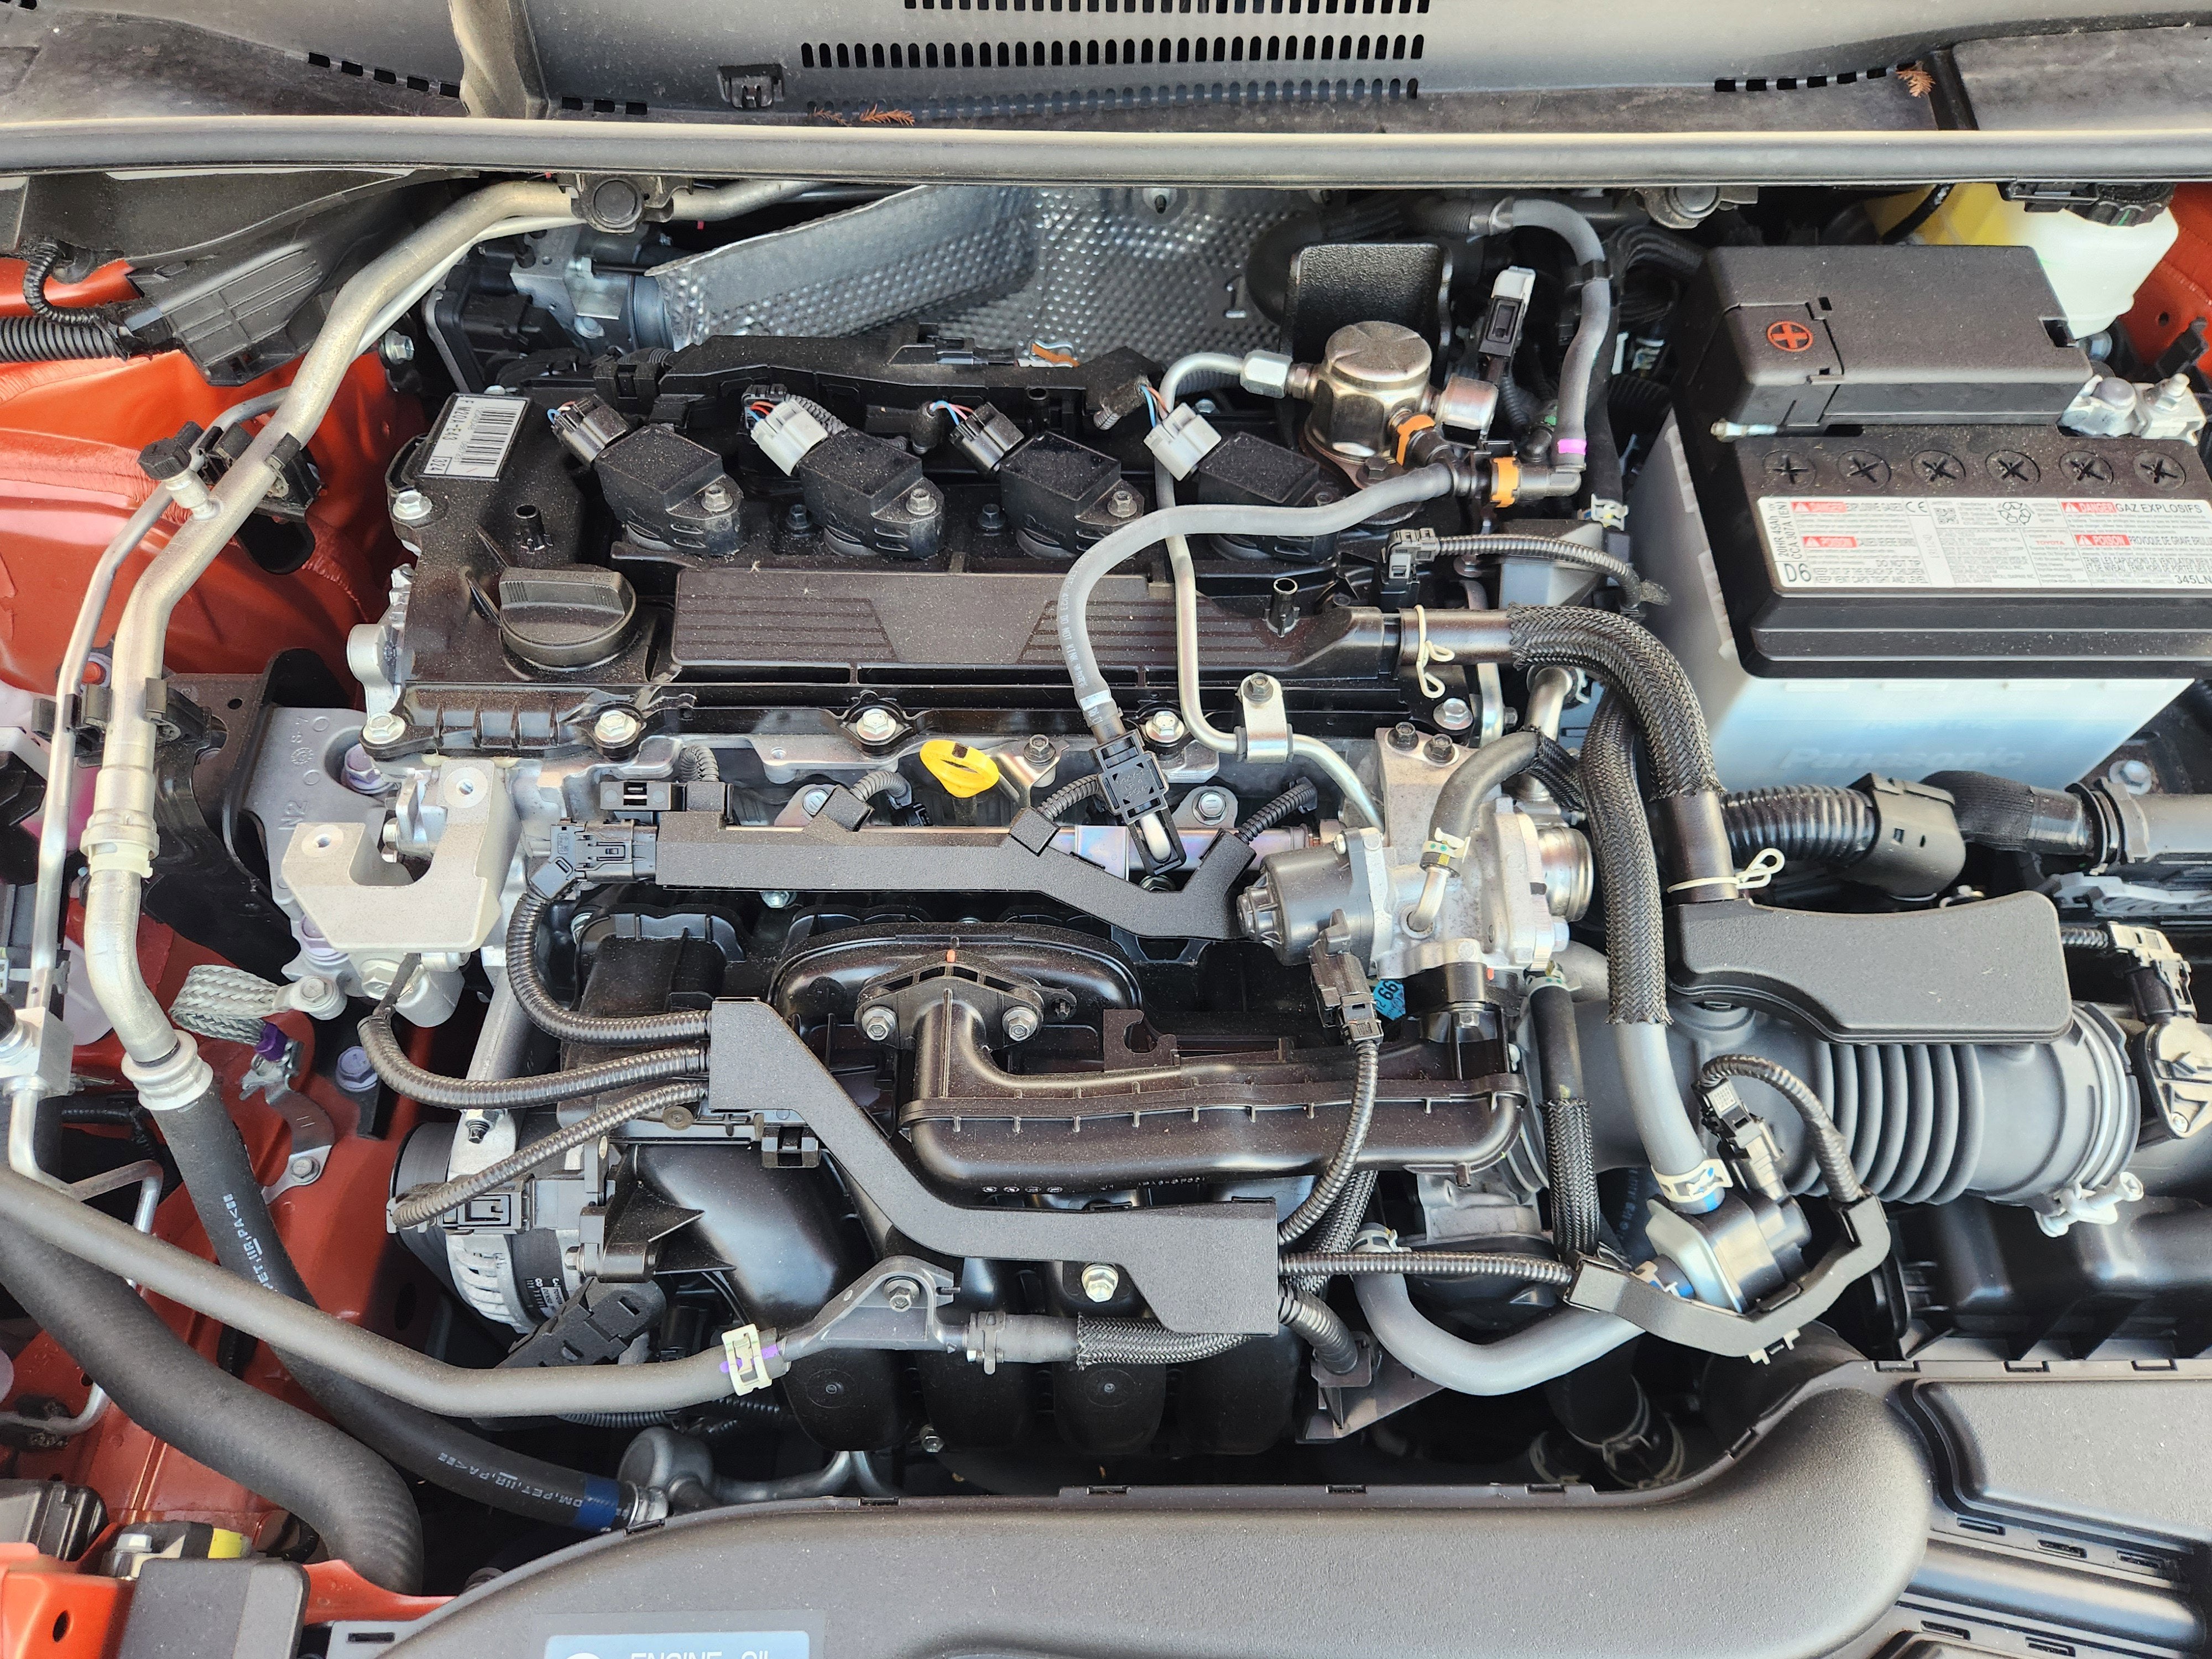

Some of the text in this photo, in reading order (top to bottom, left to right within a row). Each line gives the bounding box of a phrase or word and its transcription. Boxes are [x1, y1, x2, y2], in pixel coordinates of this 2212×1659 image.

[429, 458, 447, 471] 324
[1776, 502, 1791, 518] (EN)
[2080, 503, 2203, 513] DANGER GAZ EXPLOSIFS
[1773, 537, 1788, 557] 20HR
[2093, 536, 2125, 546] POISON
[2128, 536, 2160, 545] PROVOQUE
[1787, 541, 1802, 559] CCA
[1784, 563, 1812, 582] D6
[1060, 614, 1069, 625] DO
[1061, 627, 1072, 640] NOT
[1065, 644, 1079, 664] KINK
[1777, 747, 2026, 770] Panasonic
